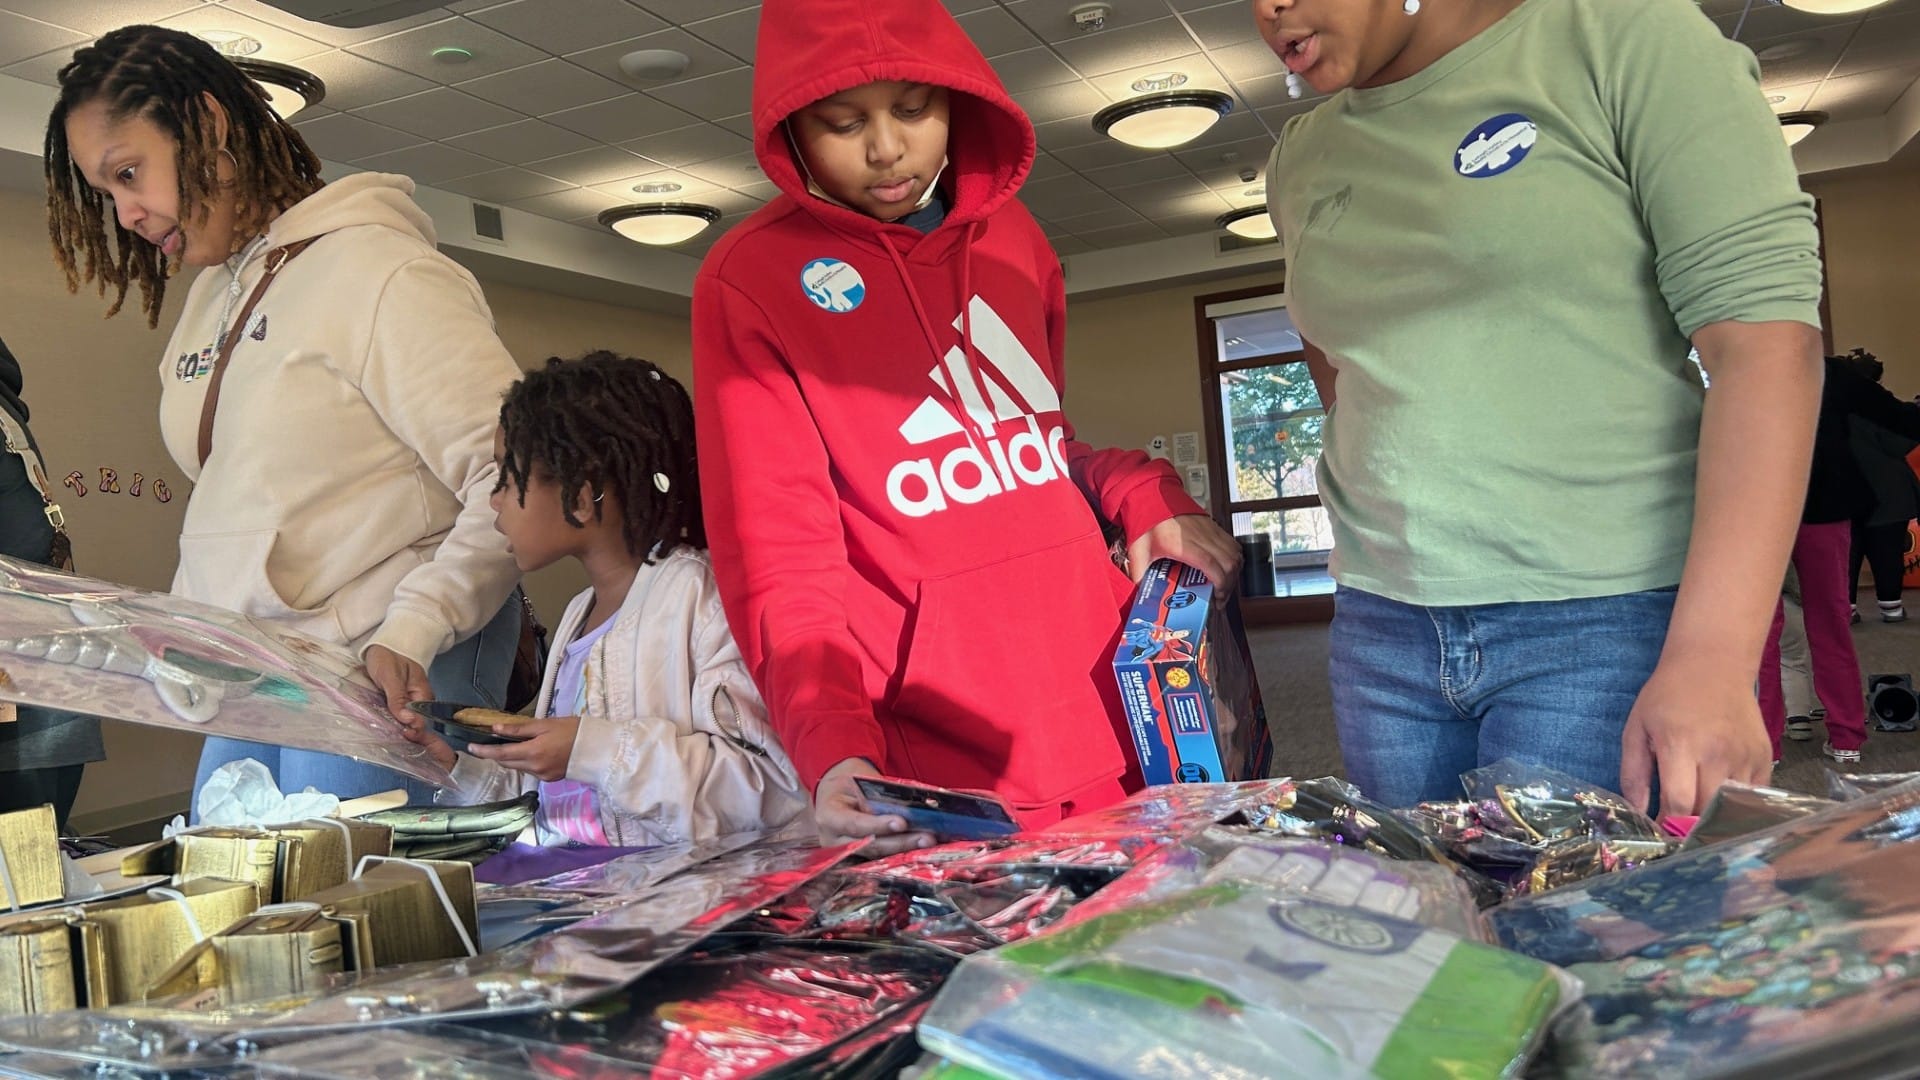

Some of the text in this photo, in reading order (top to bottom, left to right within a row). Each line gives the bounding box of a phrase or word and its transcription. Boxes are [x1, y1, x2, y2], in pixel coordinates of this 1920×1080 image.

[64, 467, 172, 503] TRIC
[886, 413, 1070, 517] adid
[1131, 670, 1153, 723] SUPERMAN
